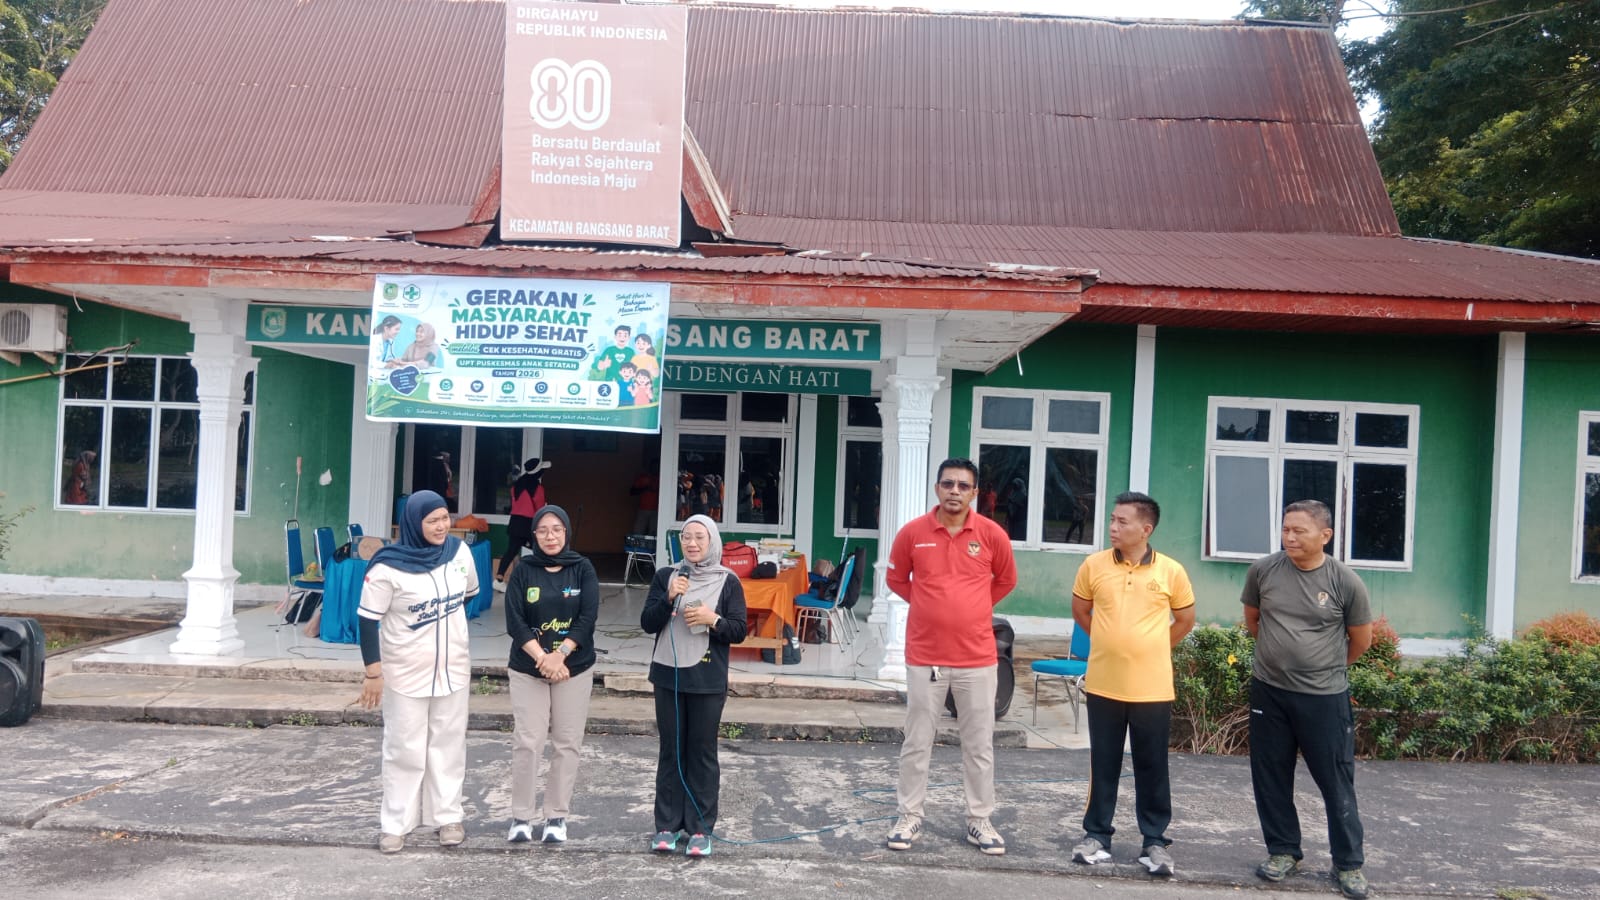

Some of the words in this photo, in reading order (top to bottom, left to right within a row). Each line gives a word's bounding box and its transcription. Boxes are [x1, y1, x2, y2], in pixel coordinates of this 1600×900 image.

[516, 7, 599, 22] DIRGAHAYU
[516, 23, 587, 38] REPUBLIK
[590, 26, 668, 41] INDONESIA
[529, 57, 612, 131] 80
[532, 134, 589, 150] Bersatu
[591, 137, 662, 153] Berdaulat
[531, 152, 581, 170] Rakyat
[584, 154, 654, 173] Sejahtera
[531, 169, 601, 187] Indonesia
[604, 174, 637, 191] Maju
[509, 218, 573, 235] KECAMATAN
[575, 222, 633, 237] RANGSANG
[636, 224, 670, 239] BARAT
[466, 289, 578, 309] GERAKAN
[452, 307, 592, 327] MASYARAKAT
[306, 312, 371, 336] KAN
[666, 323, 752, 349] SANG
[764, 326, 870, 352] BARAT
[456, 324, 519, 340] HIDUP
[524, 325, 588, 343] SEHAT
[482, 346, 500, 354] CEK
[501, 346, 550, 355] KESEHATAN
[551, 349, 582, 357] GRATIS
[518, 370, 540, 378] 2026
[544, 361, 577, 369] SETATAH
[688, 365, 781, 385] DENGAN
[788, 370, 840, 388] HATI
